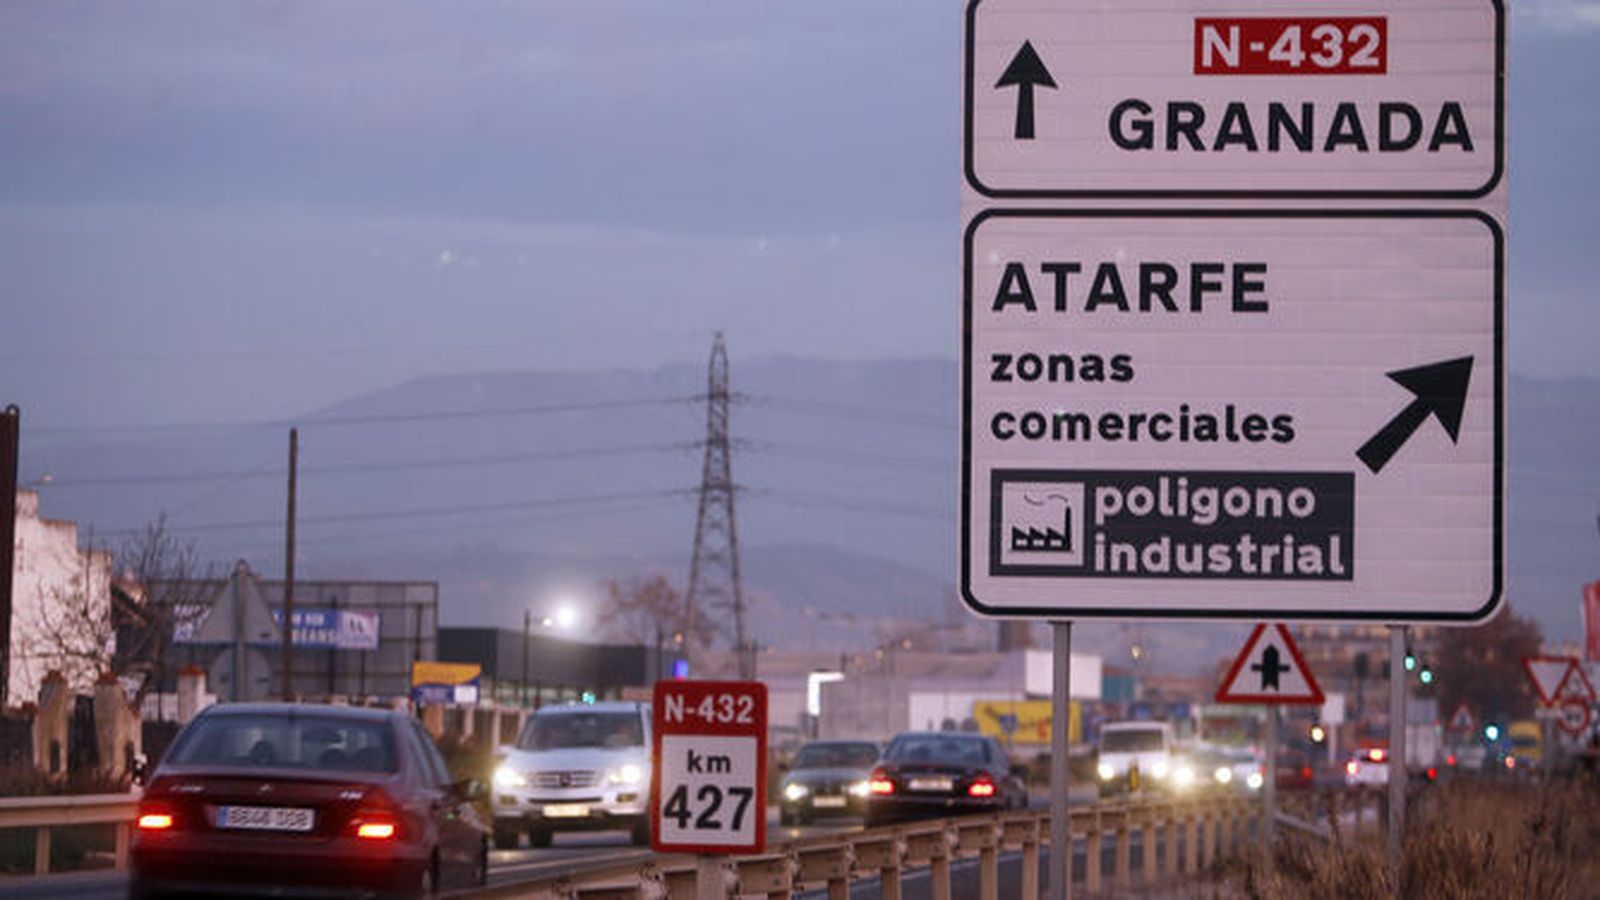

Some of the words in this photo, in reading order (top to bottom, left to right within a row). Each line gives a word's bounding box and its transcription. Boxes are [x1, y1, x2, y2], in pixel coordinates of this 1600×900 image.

[1202, 24, 1380, 67] N-432
[1109, 99, 1474, 152] GRANADA
[992, 262, 1269, 312] ATARFE
[991, 353, 1134, 382] zonas
[991, 404, 1295, 443] comerciales
[1095, 477, 1316, 525] poligono
[1094, 533, 1345, 576] industrial
[665, 694, 755, 724] N-432
[687, 749, 732, 773] km
[664, 785, 754, 832] 427
